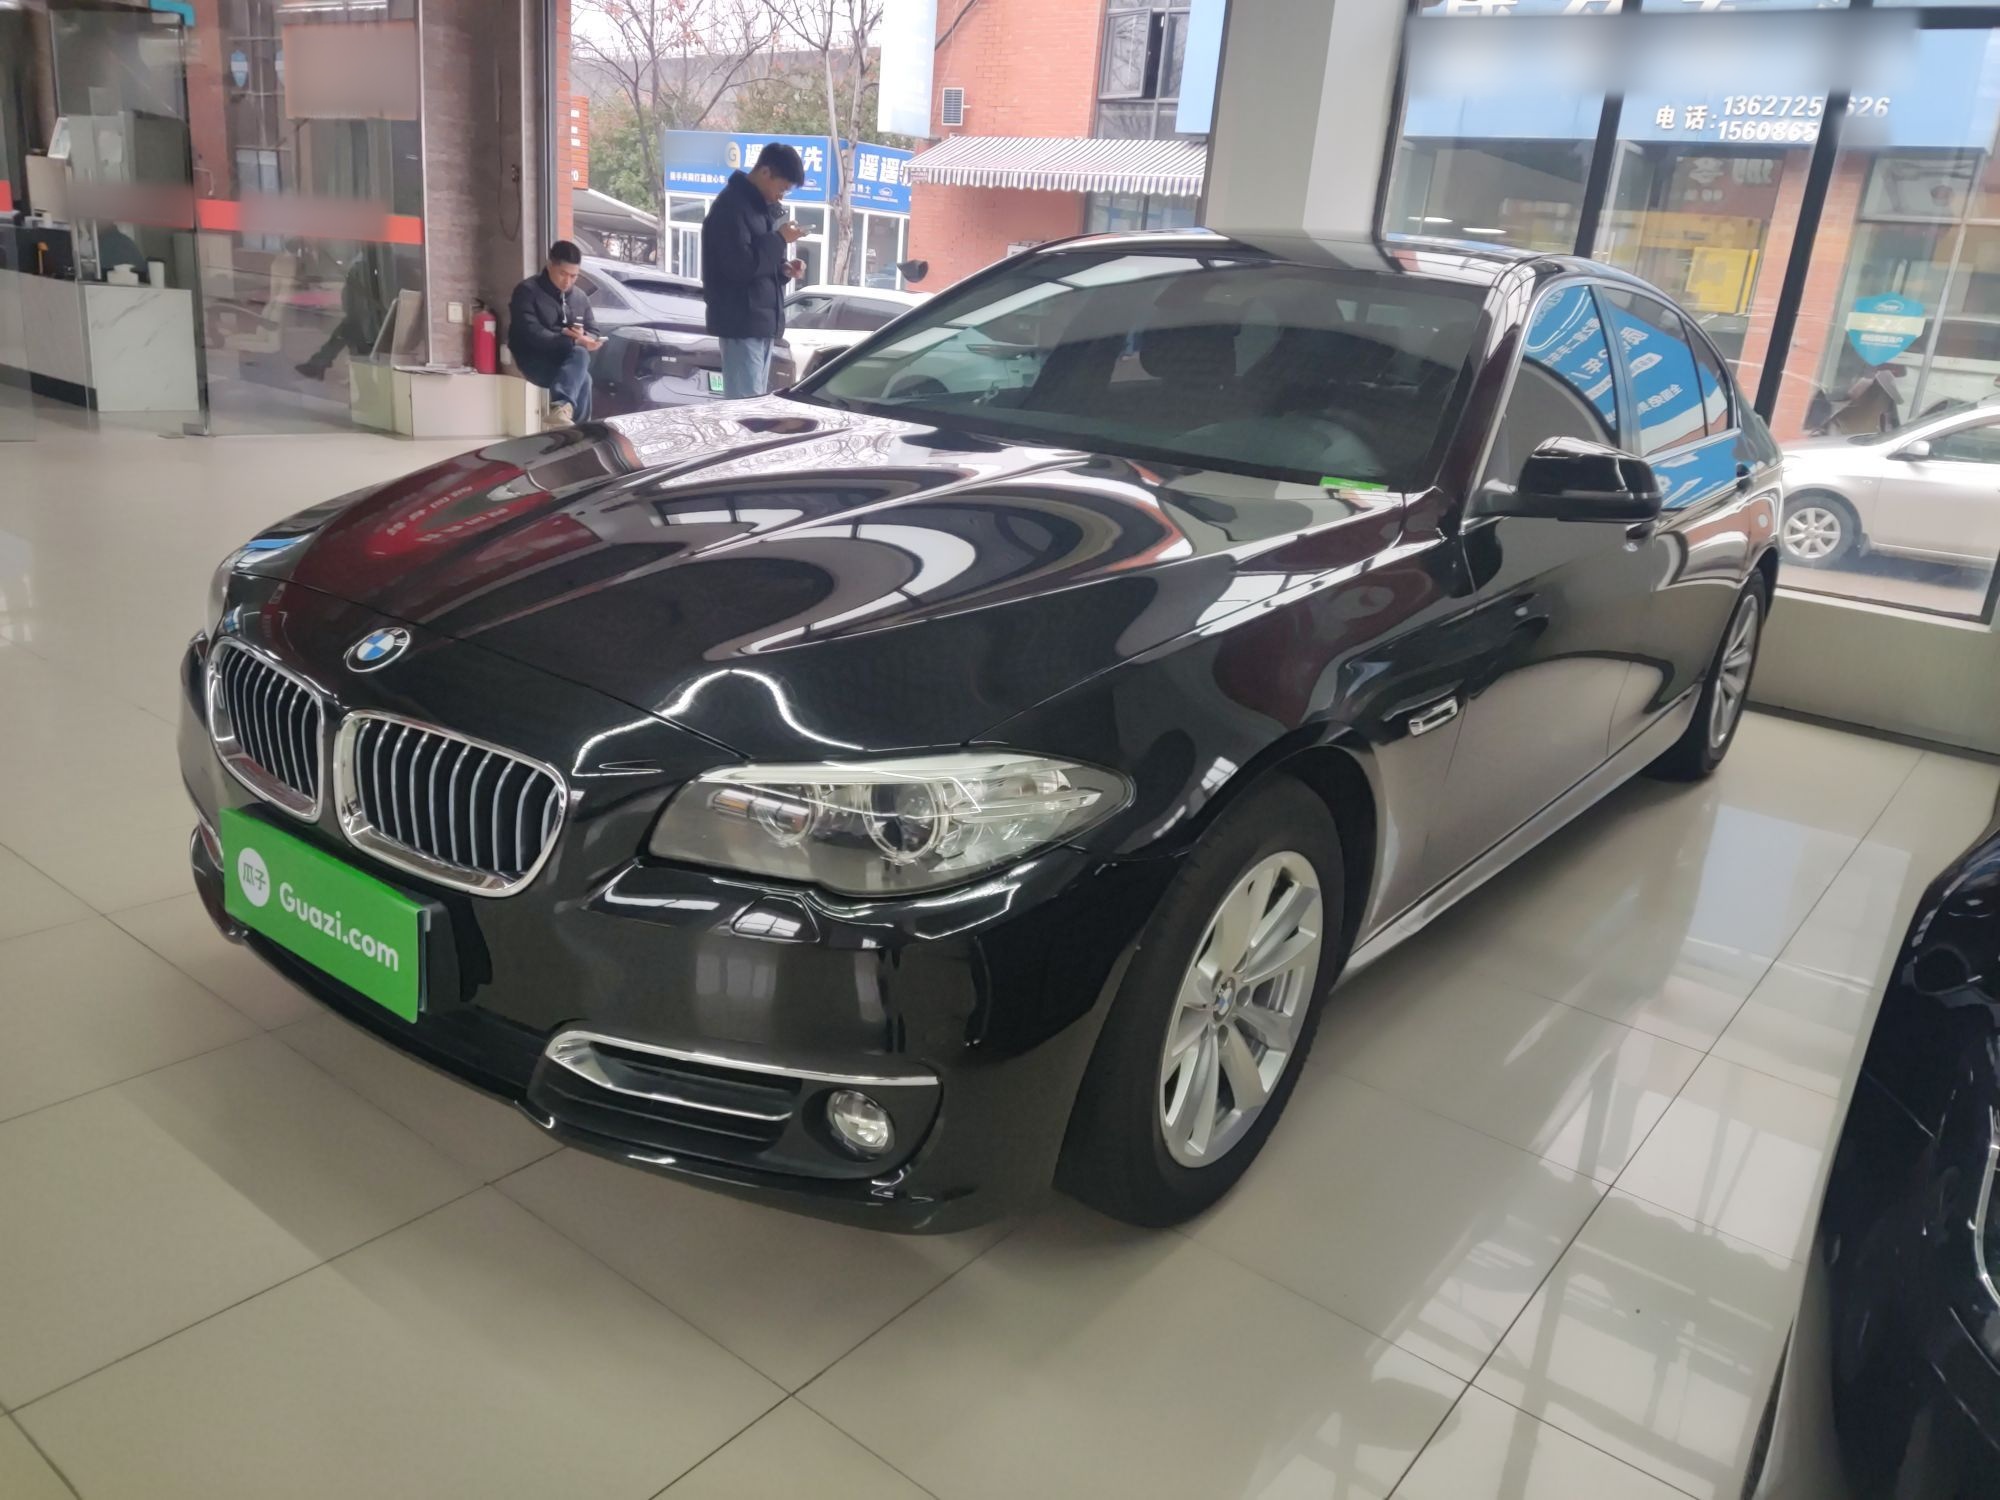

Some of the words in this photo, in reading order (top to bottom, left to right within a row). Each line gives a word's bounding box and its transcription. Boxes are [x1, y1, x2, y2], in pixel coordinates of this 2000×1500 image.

[1656, 104, 1717, 131] 电话:
[1723, 94, 1890, 119] 1362725626
[858, 152, 905, 185] 遥遥
[242, 861, 267, 892] 瓜子
[278, 881, 400, 973] Guazi.com
